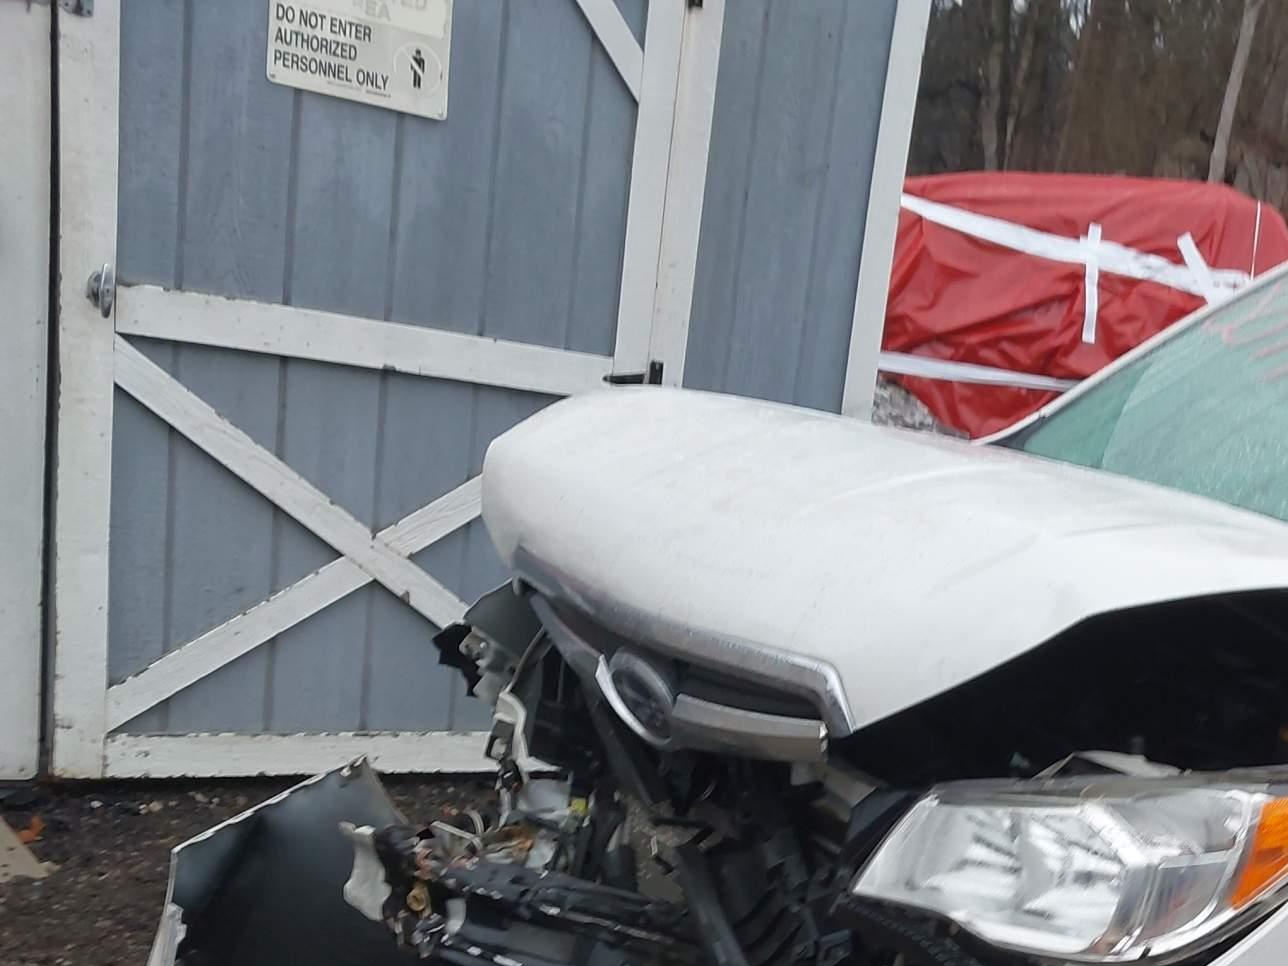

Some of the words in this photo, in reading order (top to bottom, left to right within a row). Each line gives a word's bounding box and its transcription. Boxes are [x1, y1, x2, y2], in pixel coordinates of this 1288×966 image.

[275, 3, 296, 24] DO
[299, 10, 326, 31] NOT
[330, 17, 372, 43] ENTER
[274, 27, 358, 62] AUTHORIZED
[273, 48, 353, 83] PERSONNEL
[356, 68, 389, 91] ONLY
